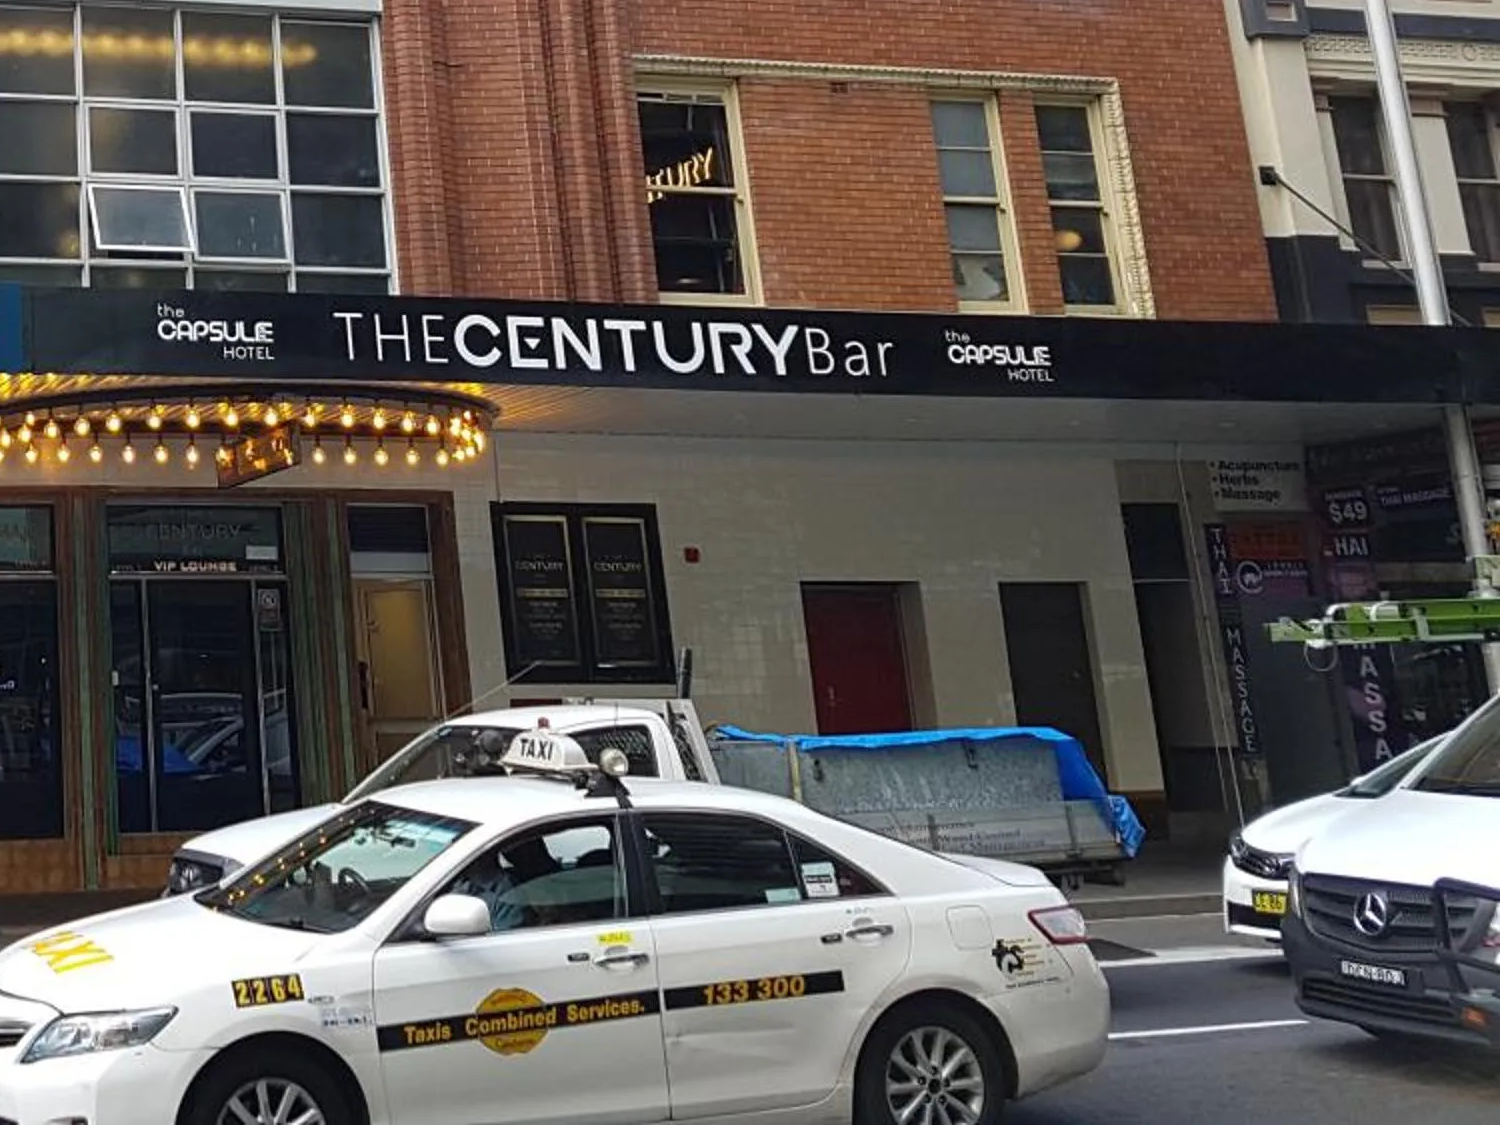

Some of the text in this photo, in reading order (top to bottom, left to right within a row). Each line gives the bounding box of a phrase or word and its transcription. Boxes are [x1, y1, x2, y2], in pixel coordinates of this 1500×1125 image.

[157, 303, 185, 318] the
[157, 319, 274, 343] CAPSULE
[945, 330, 970, 343] the
[223, 346, 275, 360] HOTEL
[948, 344, 1052, 366] CAPSULE
[1007, 368, 1055, 382] HOTEL
[1218, 458, 1300, 473] Acupuncture
[1219, 474, 1260, 487] Herbs
[1221, 487, 1282, 503] Massage
[1328, 501, 1368, 524] $49
[154, 560, 177, 572] VIP
[180, 560, 236, 572] LOUNGE
[521, 738, 554, 761] TAXI
[31, 930, 114, 974] TAXI
[234, 976, 301, 1005] 2264
[702, 976, 805, 1006] 133 300
[404, 999, 645, 1045] Taxis Combined Services.
